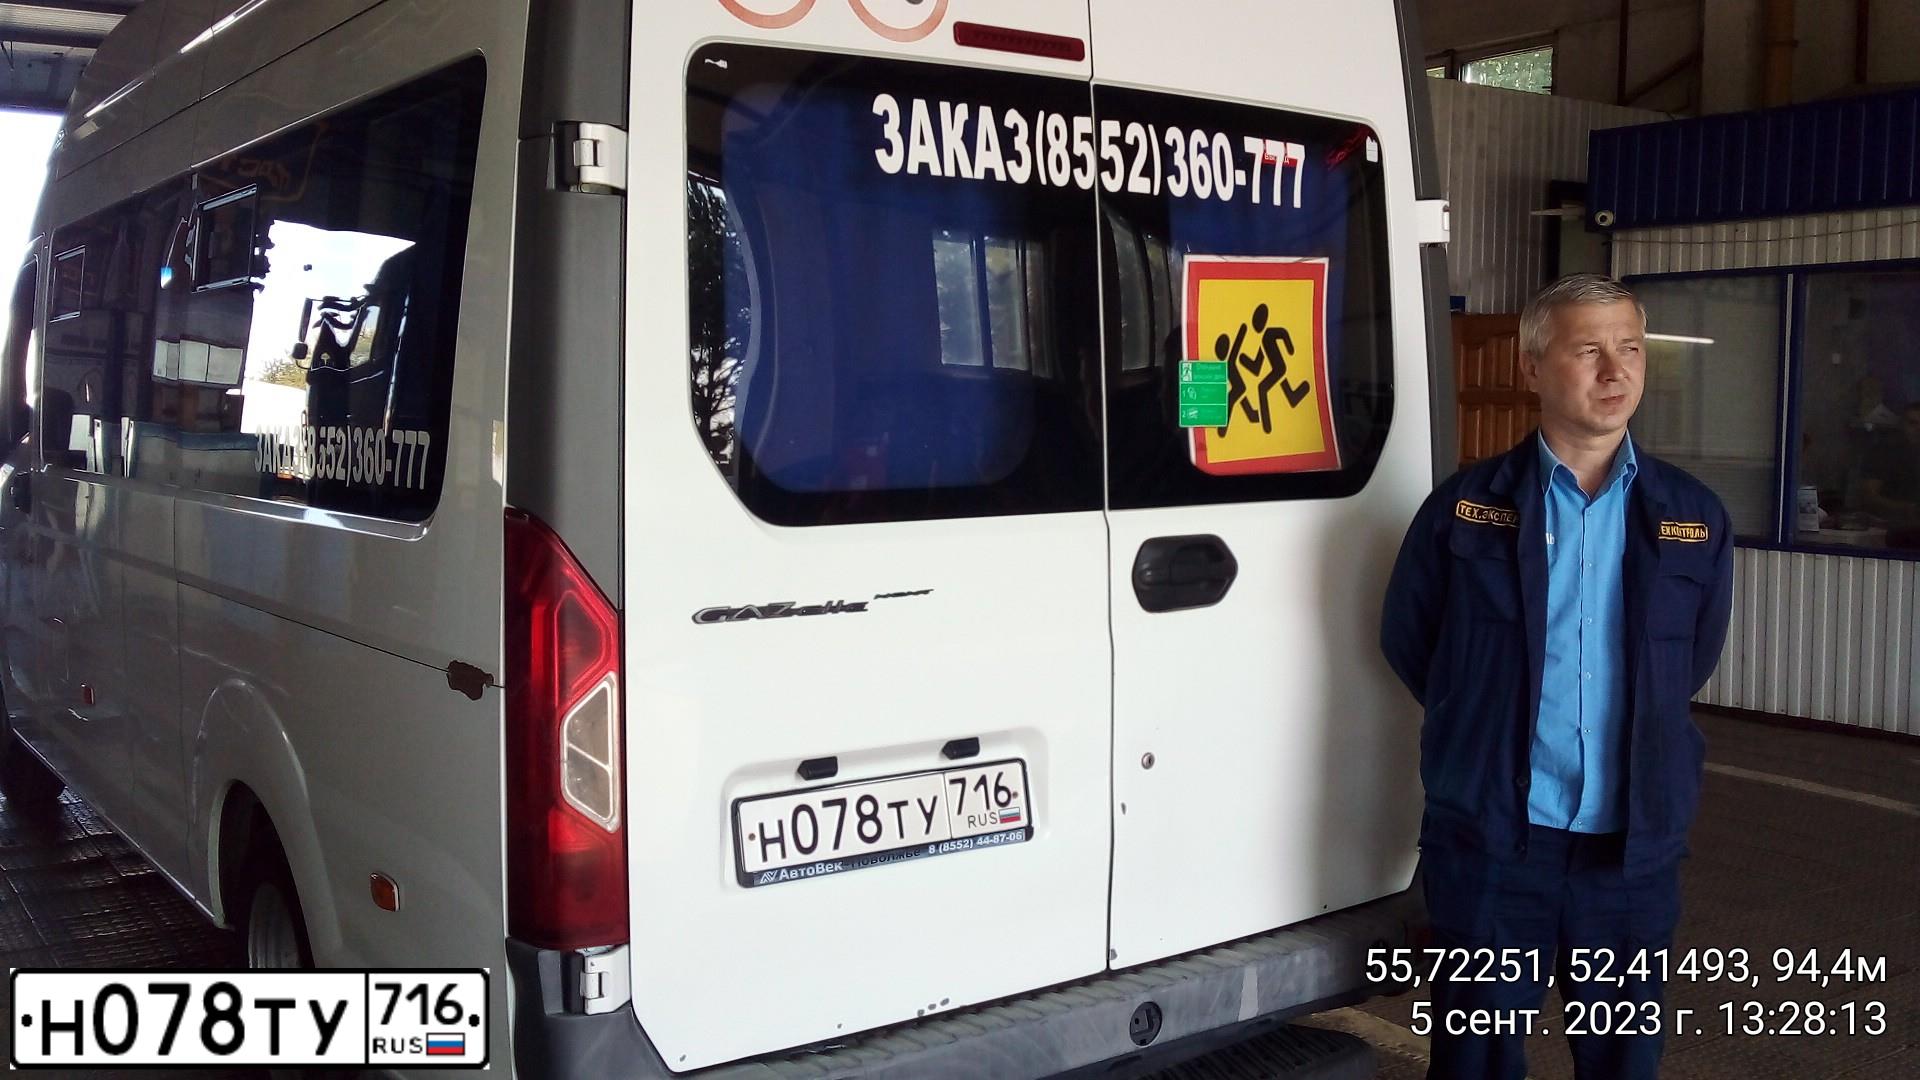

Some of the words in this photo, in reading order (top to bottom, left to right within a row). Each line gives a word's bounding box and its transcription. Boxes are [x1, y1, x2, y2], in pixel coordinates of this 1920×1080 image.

[948, 771, 1012, 816] 716
[967, 811, 998, 829] RUS
[938, 839, 974, 853] (8552)
